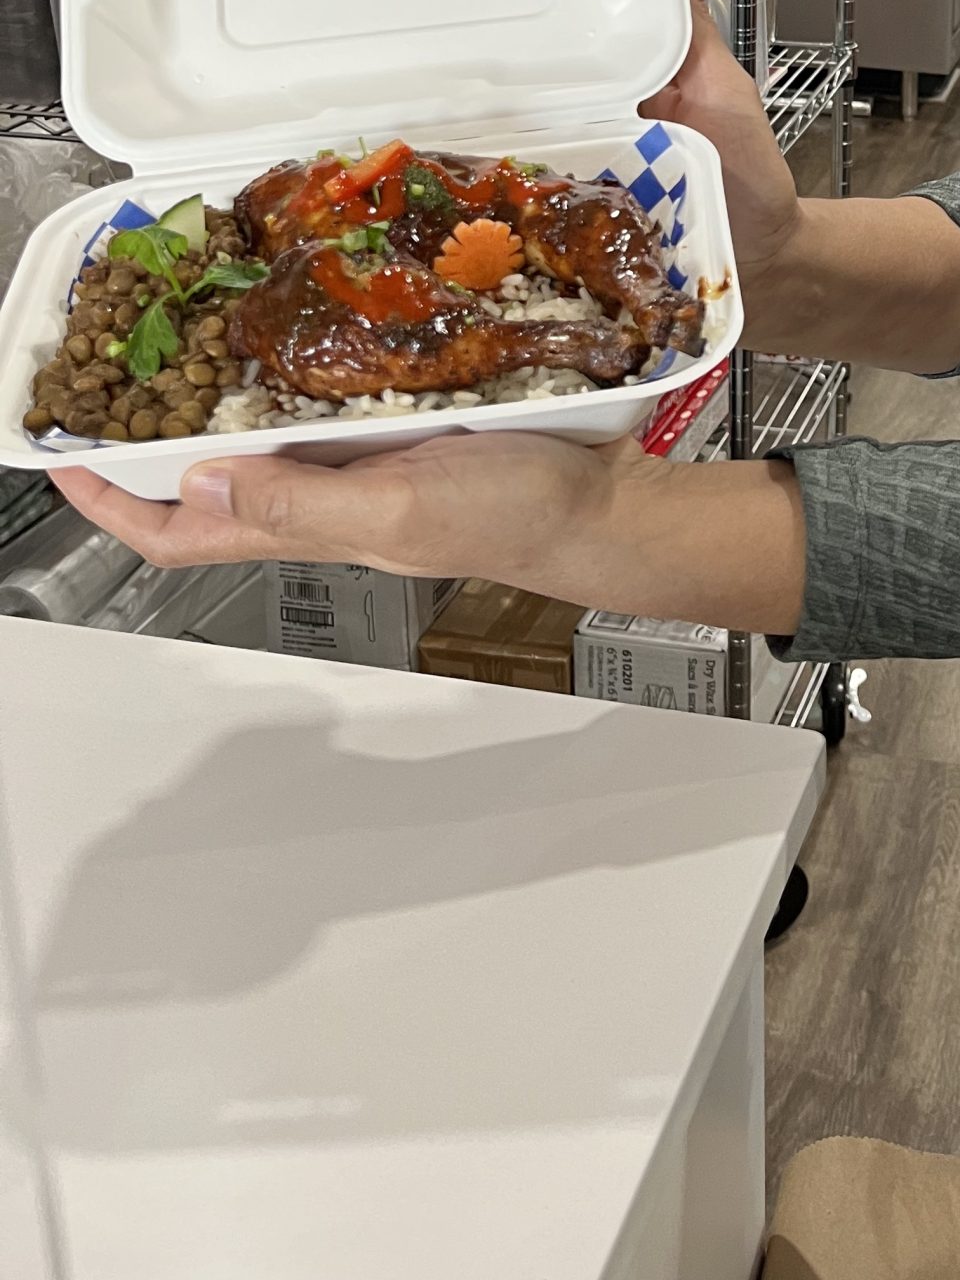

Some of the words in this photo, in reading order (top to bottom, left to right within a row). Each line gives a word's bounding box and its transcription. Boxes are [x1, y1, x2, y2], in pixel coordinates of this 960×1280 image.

[622, 649, 633, 692] 610201
[703, 659, 716, 679] Dry
[706, 680, 716, 704] Wax
